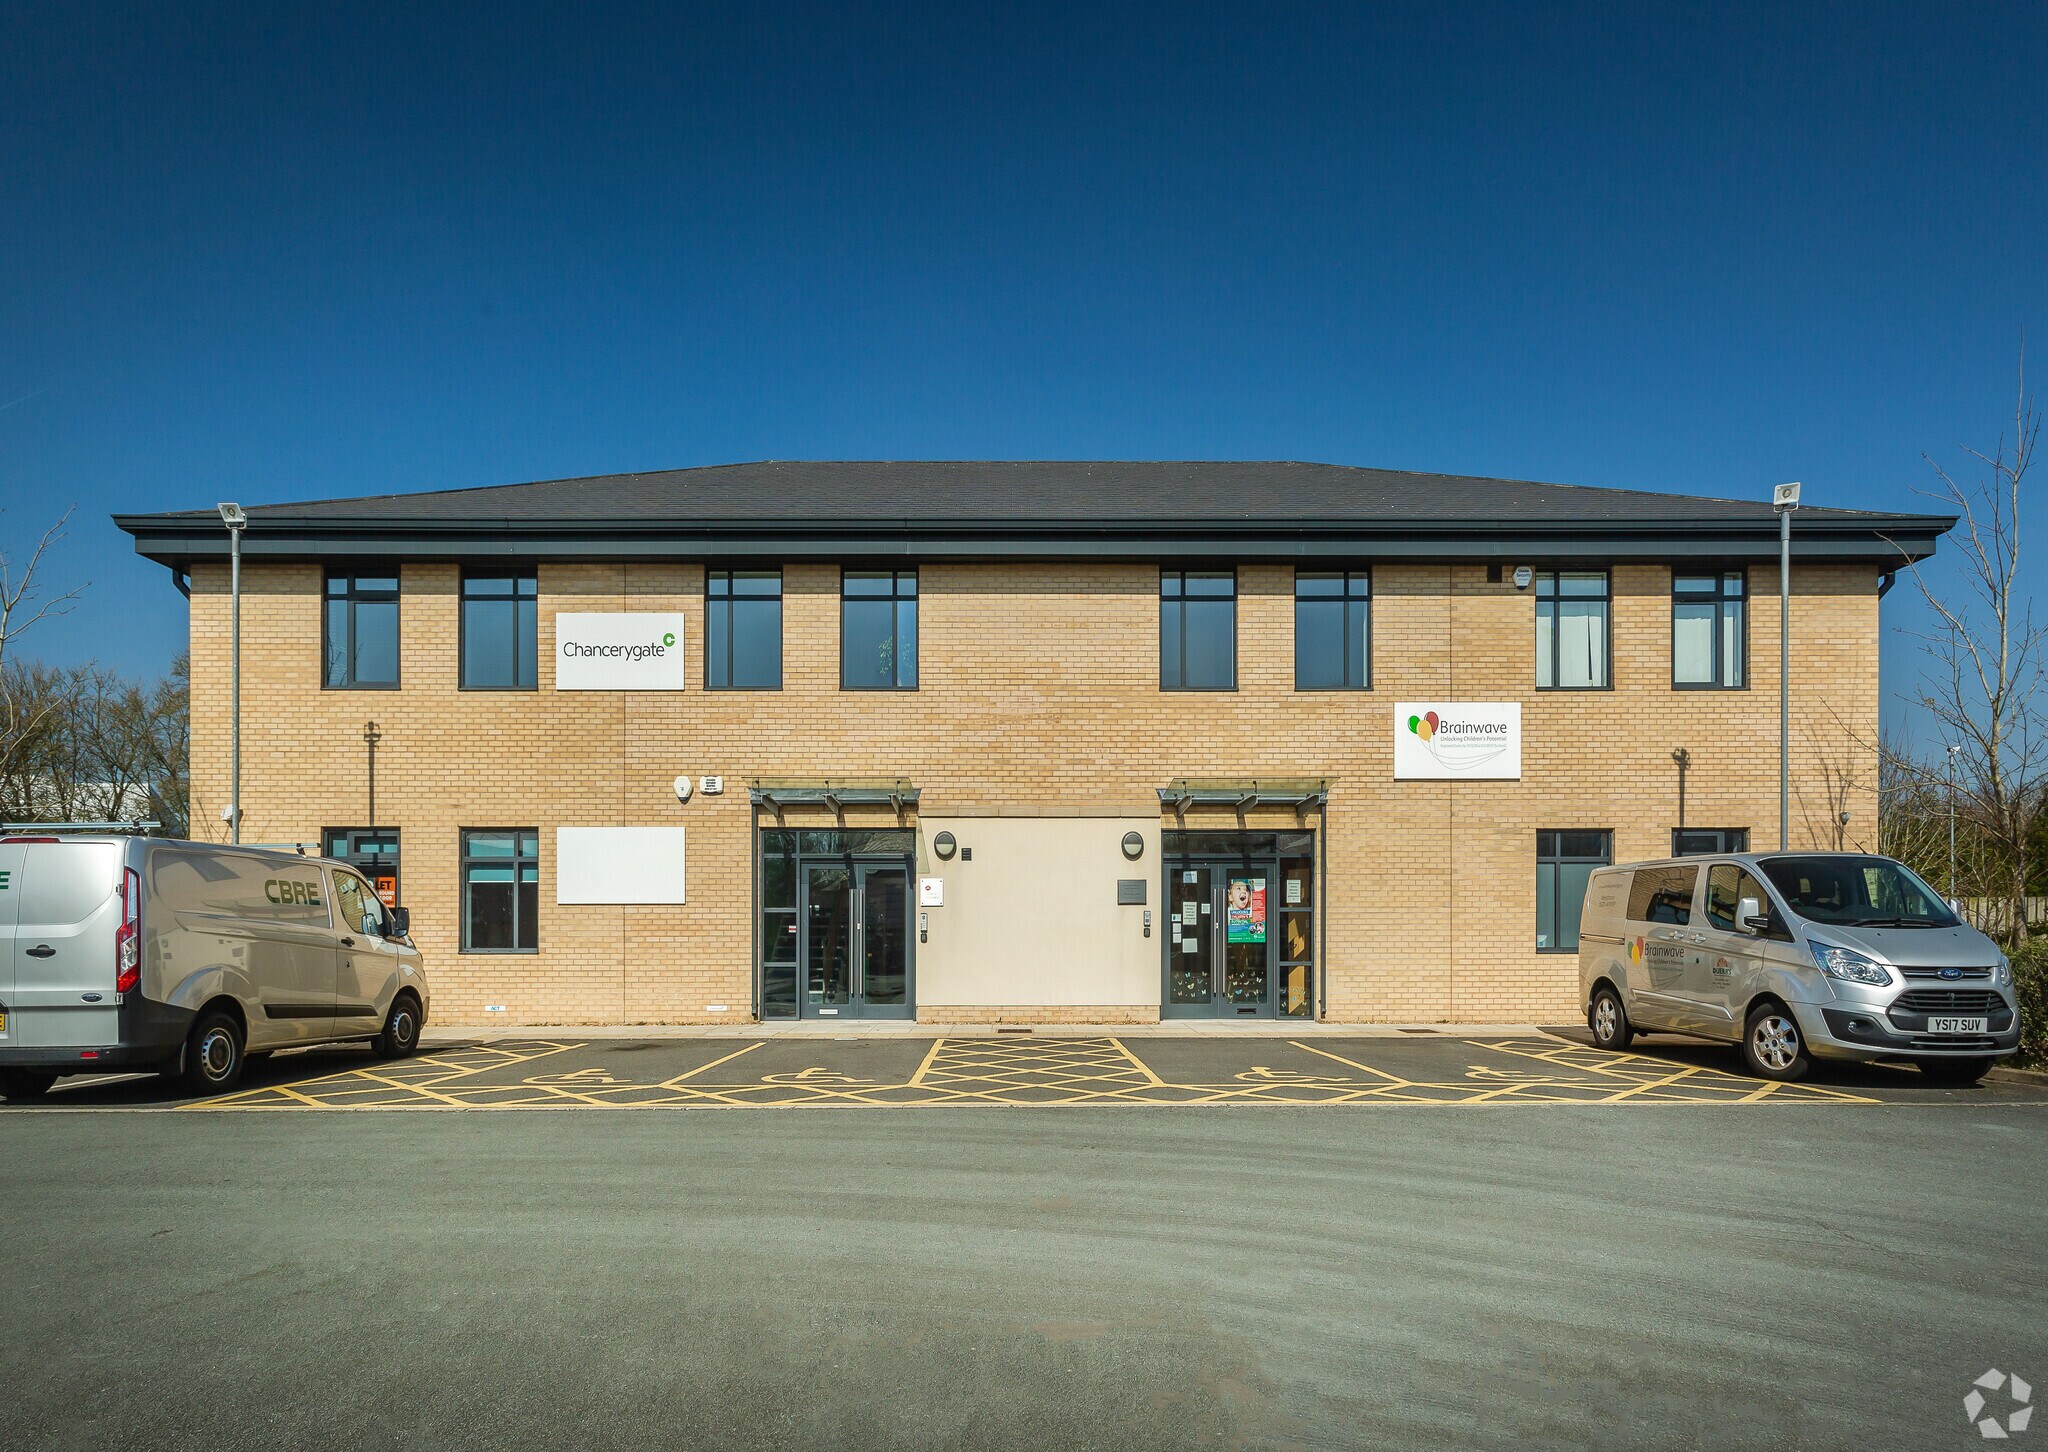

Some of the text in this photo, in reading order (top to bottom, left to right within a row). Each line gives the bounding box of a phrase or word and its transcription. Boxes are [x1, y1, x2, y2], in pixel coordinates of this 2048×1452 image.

[563, 641, 665, 662] Chancerygate
[1440, 720, 1507, 734] Brainwave
[264, 879, 320, 905] CBRE
[1644, 943, 1685, 958] Brainwave
[1935, 1018, 1981, 1032] YS17 SUV
